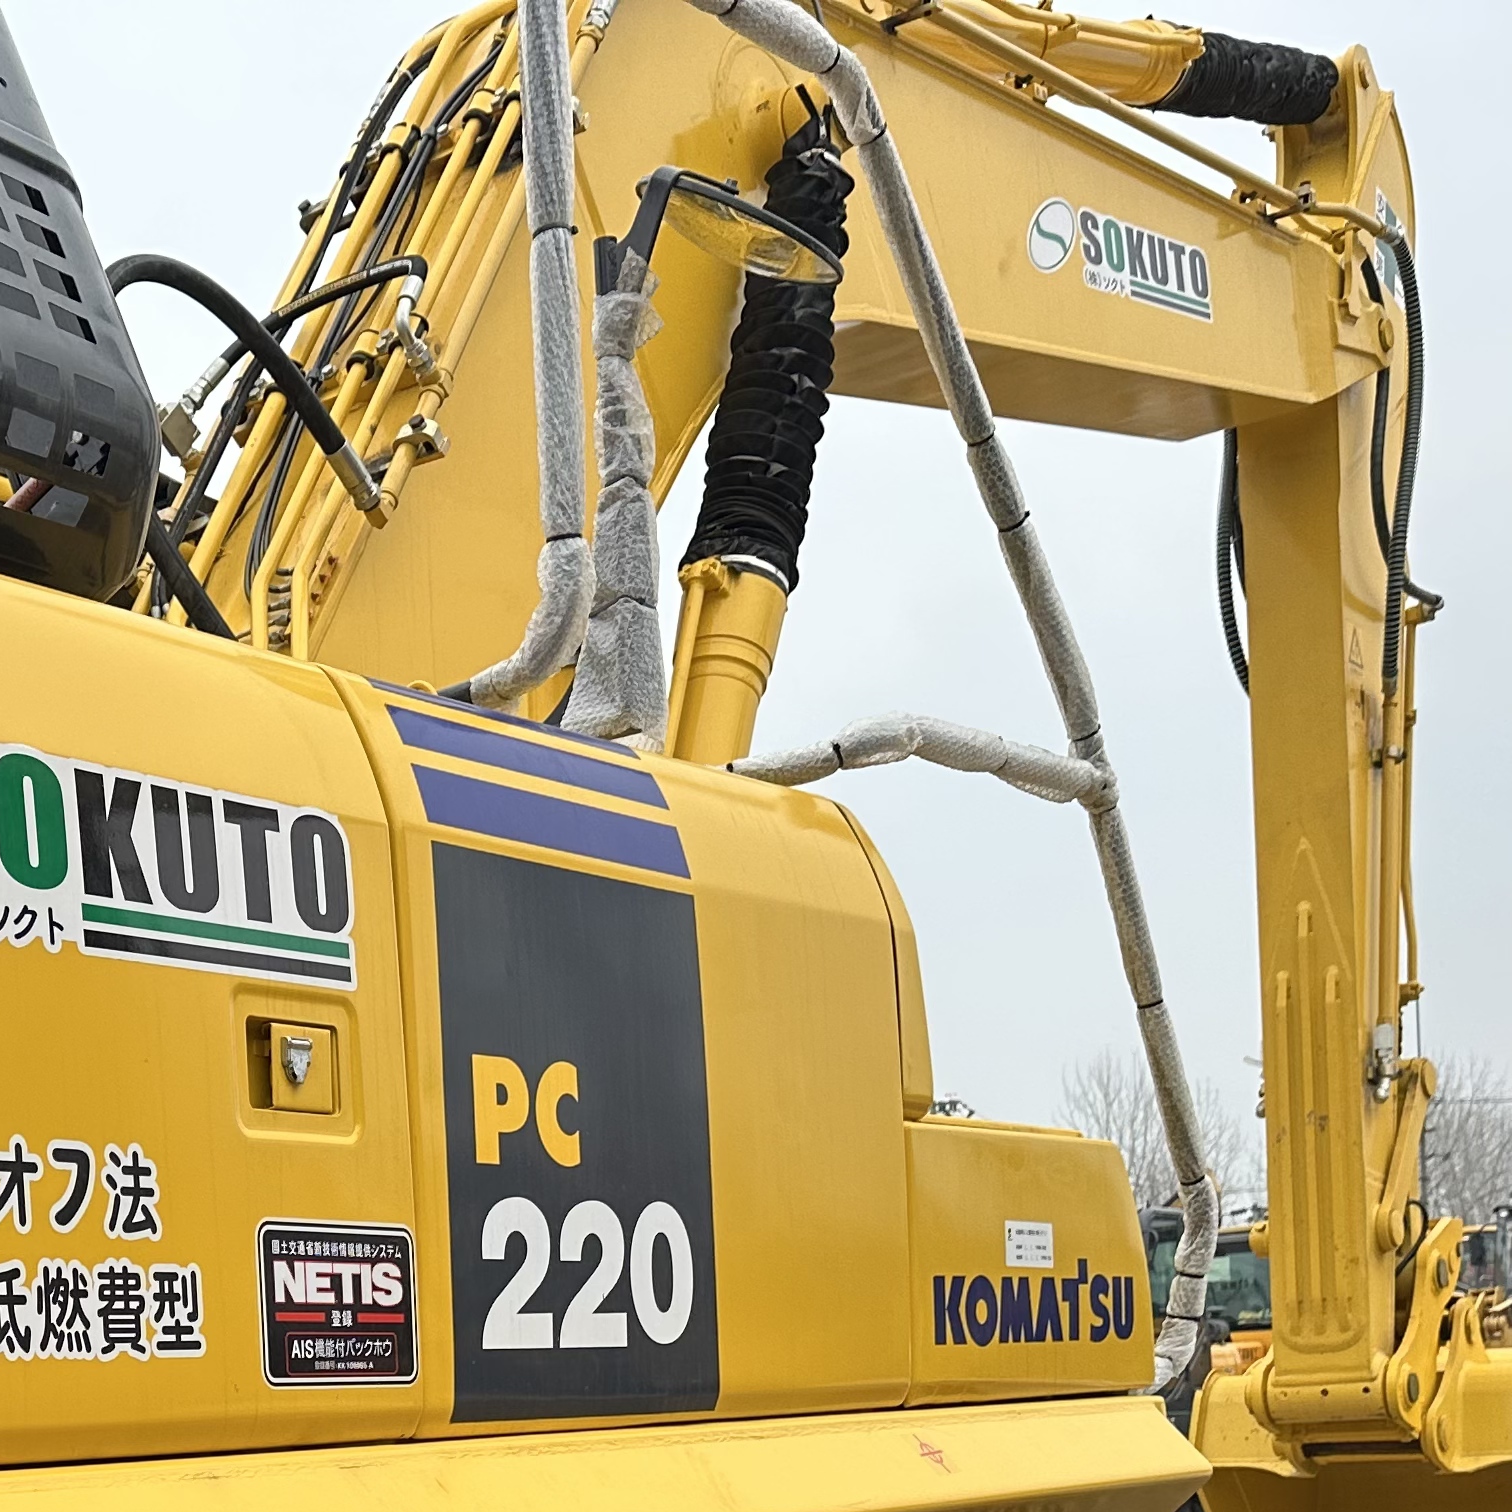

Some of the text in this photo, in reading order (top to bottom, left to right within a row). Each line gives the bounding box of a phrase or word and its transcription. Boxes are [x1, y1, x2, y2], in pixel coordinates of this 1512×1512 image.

[1079, 210, 1209, 299] SOKUTO
[471, 1053, 582, 1168] PC
[273, 1260, 404, 1307] NETIS
[481, 1196, 694, 1350] 220
[933, 1258, 1134, 1347] KOMATSU
[331, 1310, 353, 1327] 登録
